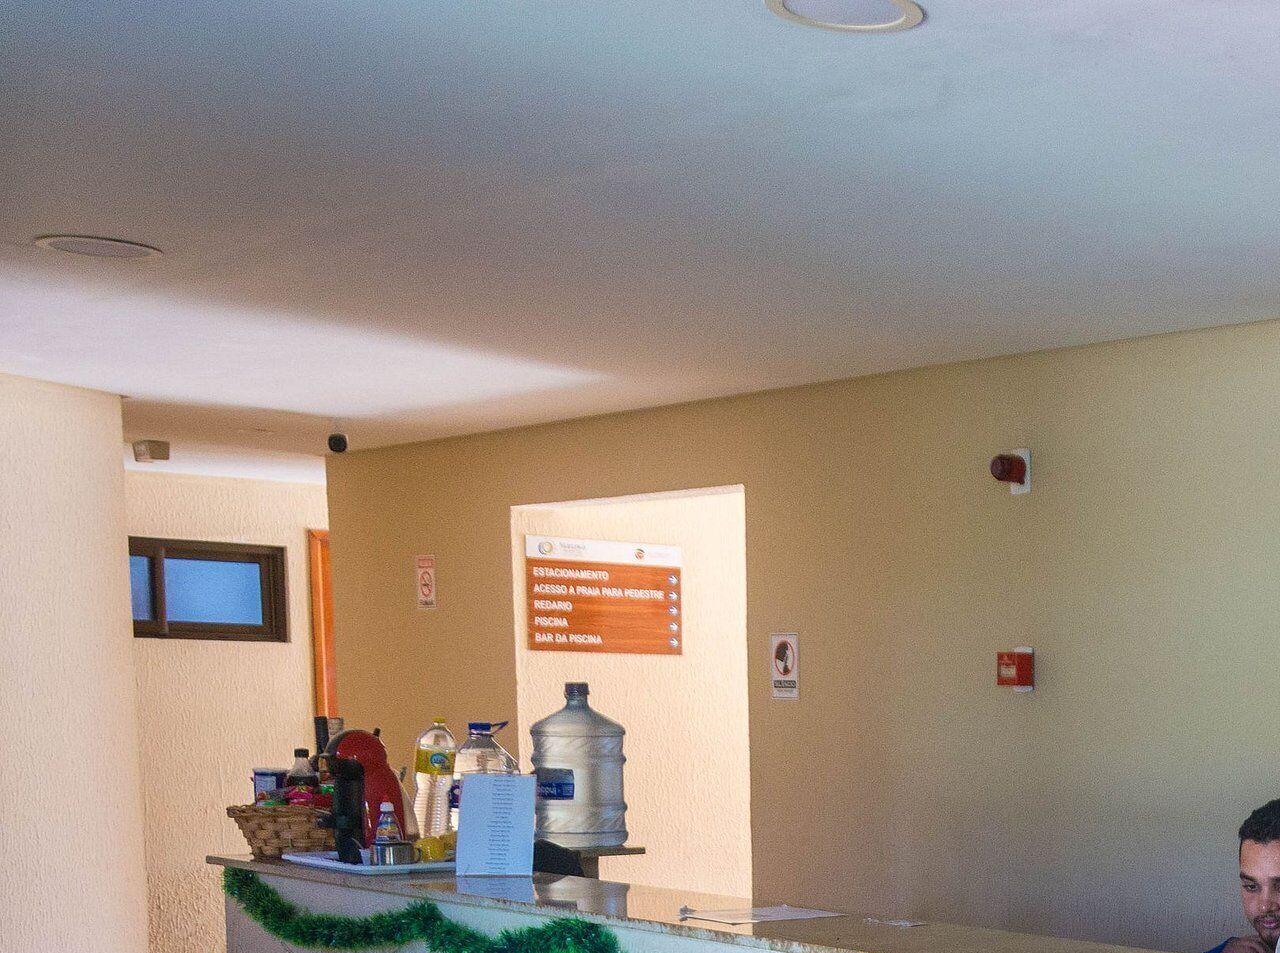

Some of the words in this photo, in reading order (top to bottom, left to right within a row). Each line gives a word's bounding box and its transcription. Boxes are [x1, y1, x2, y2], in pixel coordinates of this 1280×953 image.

[533, 566, 609, 581] ESTACIONAMENTO
[534, 583, 568, 595] ACESSO
[568, 585, 576, 595] A
[576, 585, 600, 597] PRAIA
[601, 586, 624, 598] PARA
[624, 588, 664, 600] PEDESTRE
[535, 616, 569, 627] PISCINA
[535, 633, 554, 643] BAR
[555, 633, 568, 643] DA
[569, 634, 603, 645] PISCINA
